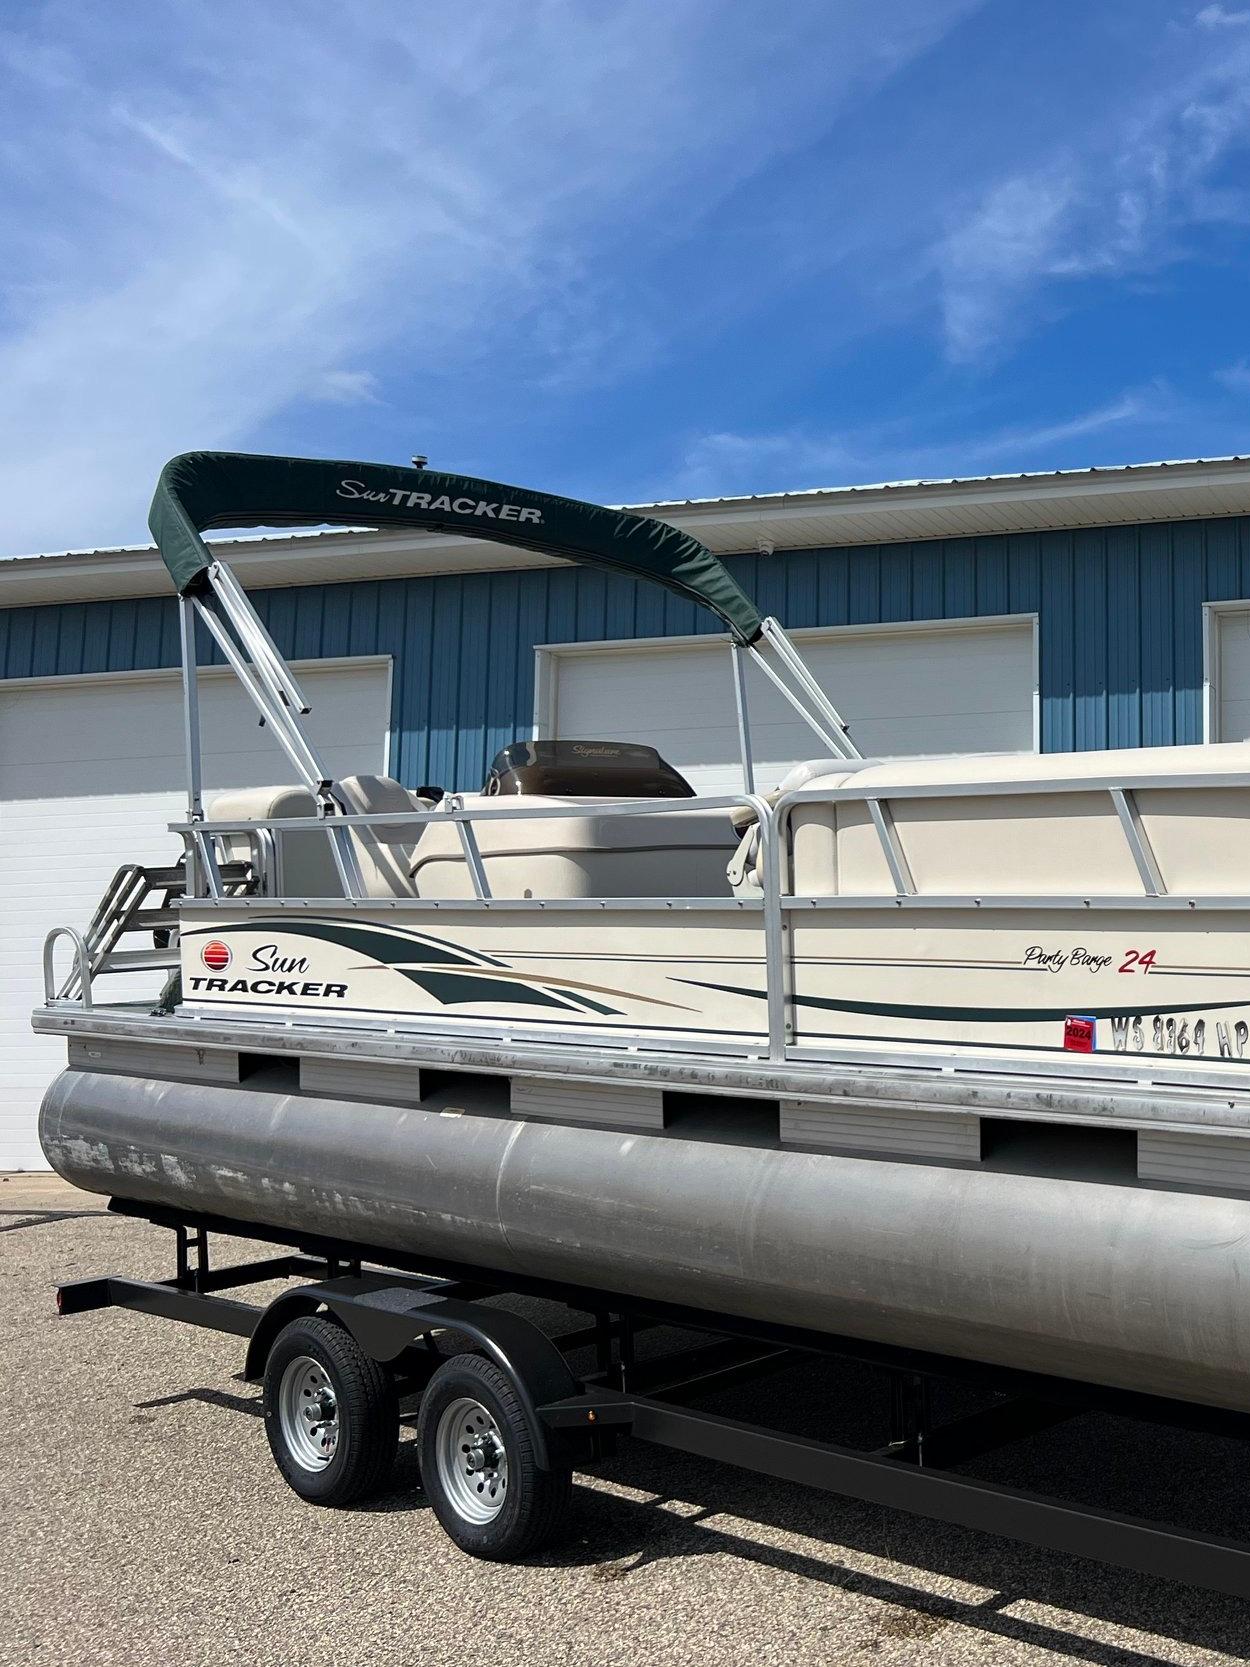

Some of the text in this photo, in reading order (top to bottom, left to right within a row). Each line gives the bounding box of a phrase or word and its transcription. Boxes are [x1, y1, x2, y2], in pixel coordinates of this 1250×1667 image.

[246, 944, 310, 974] Sun
[1023, 945, 1157, 975] Party Barge 24
[189, 976, 349, 998] TRACKER
[1066, 1025, 1092, 1041] 2024
[1110, 1014, 1145, 1052] WS
[1216, 1020, 1249, 1058] HP
